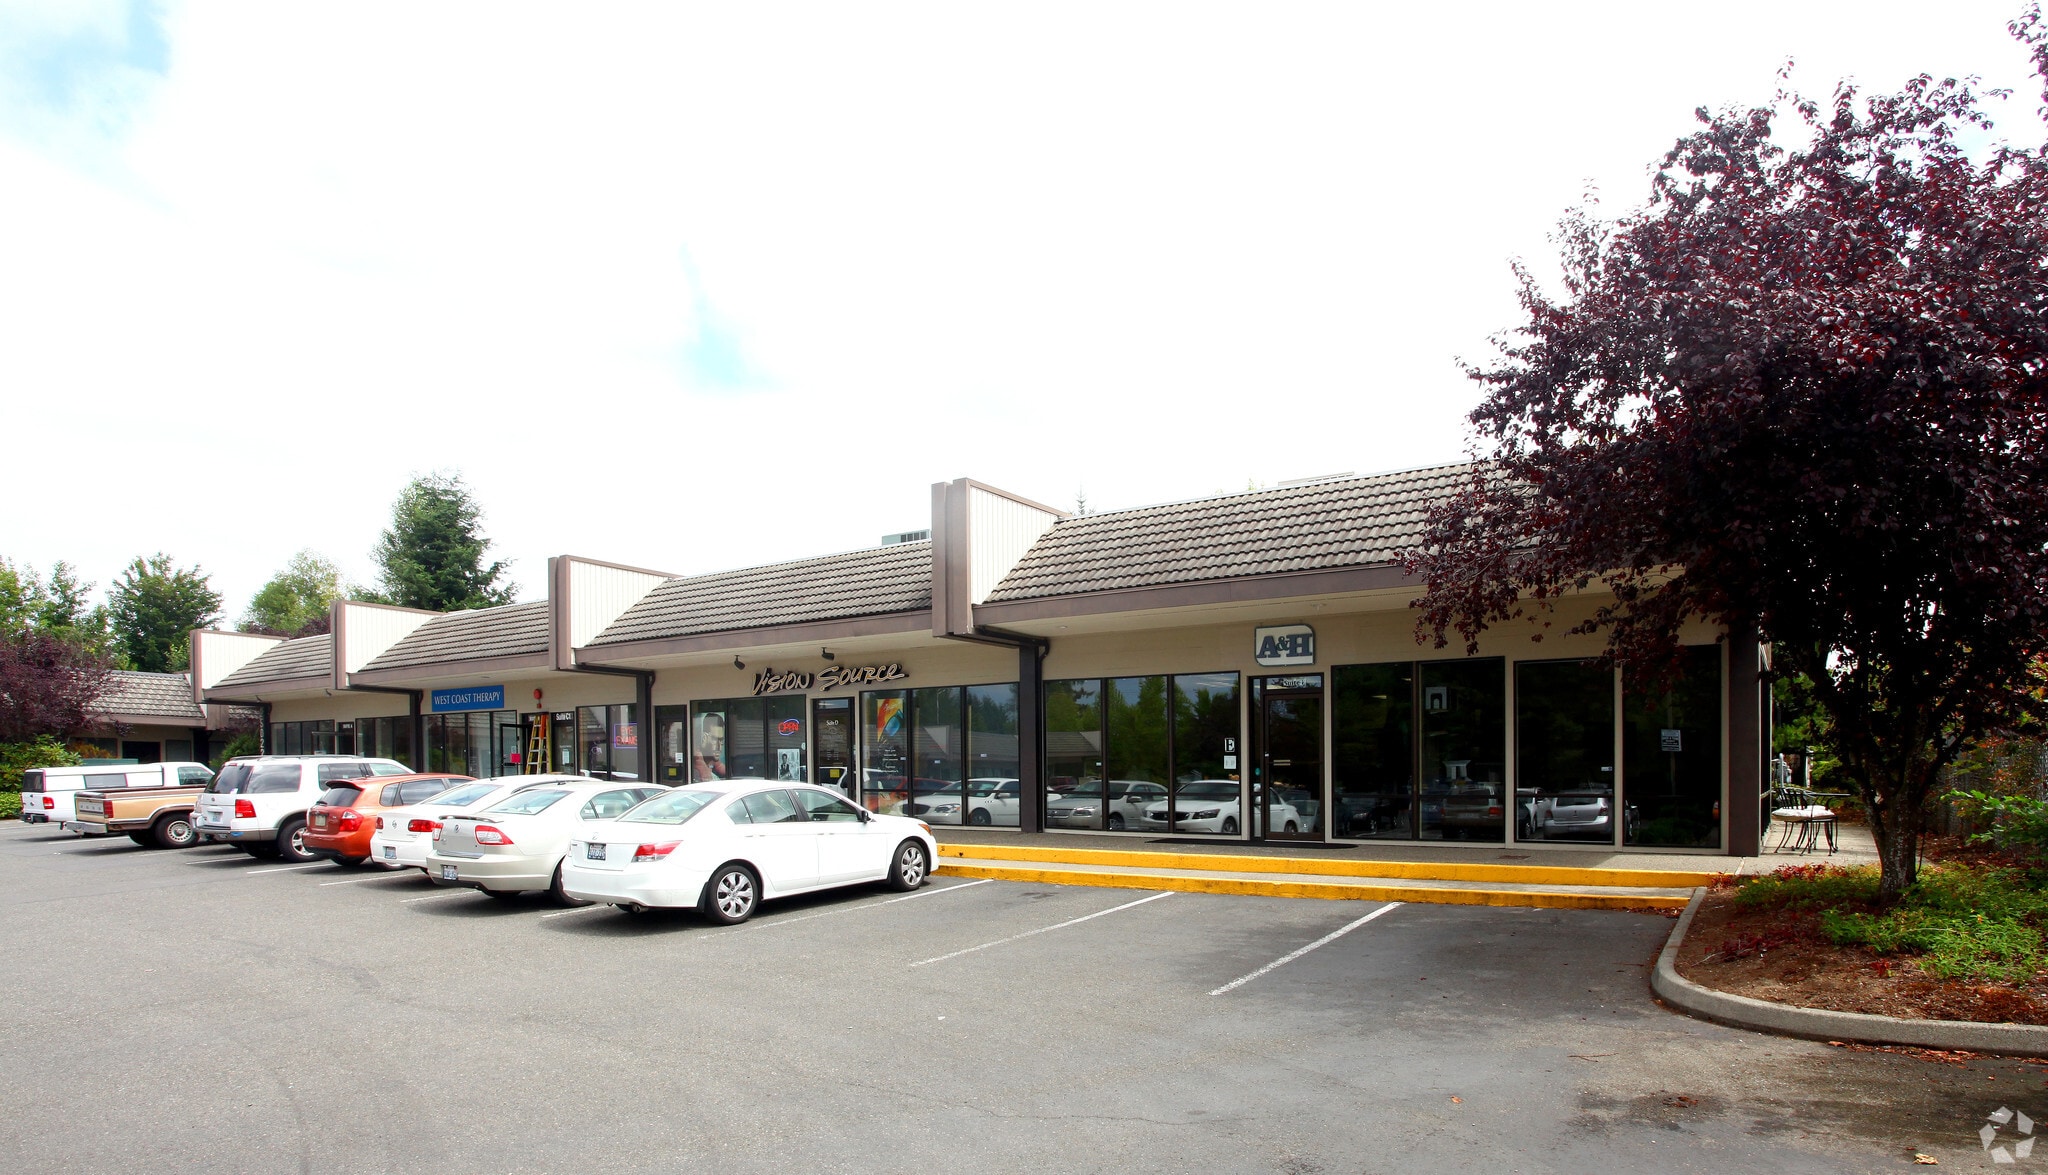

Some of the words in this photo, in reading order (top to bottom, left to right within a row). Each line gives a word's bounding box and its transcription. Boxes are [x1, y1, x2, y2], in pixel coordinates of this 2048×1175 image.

[1256, 633, 1312, 658] A&H
[434, 695, 450, 705] WEST
[451, 693, 471, 704] COAST
[473, 691, 500, 702] THERAPY
[620, 726, 633, 736] EYE
[778, 721, 799, 732] OPEN
